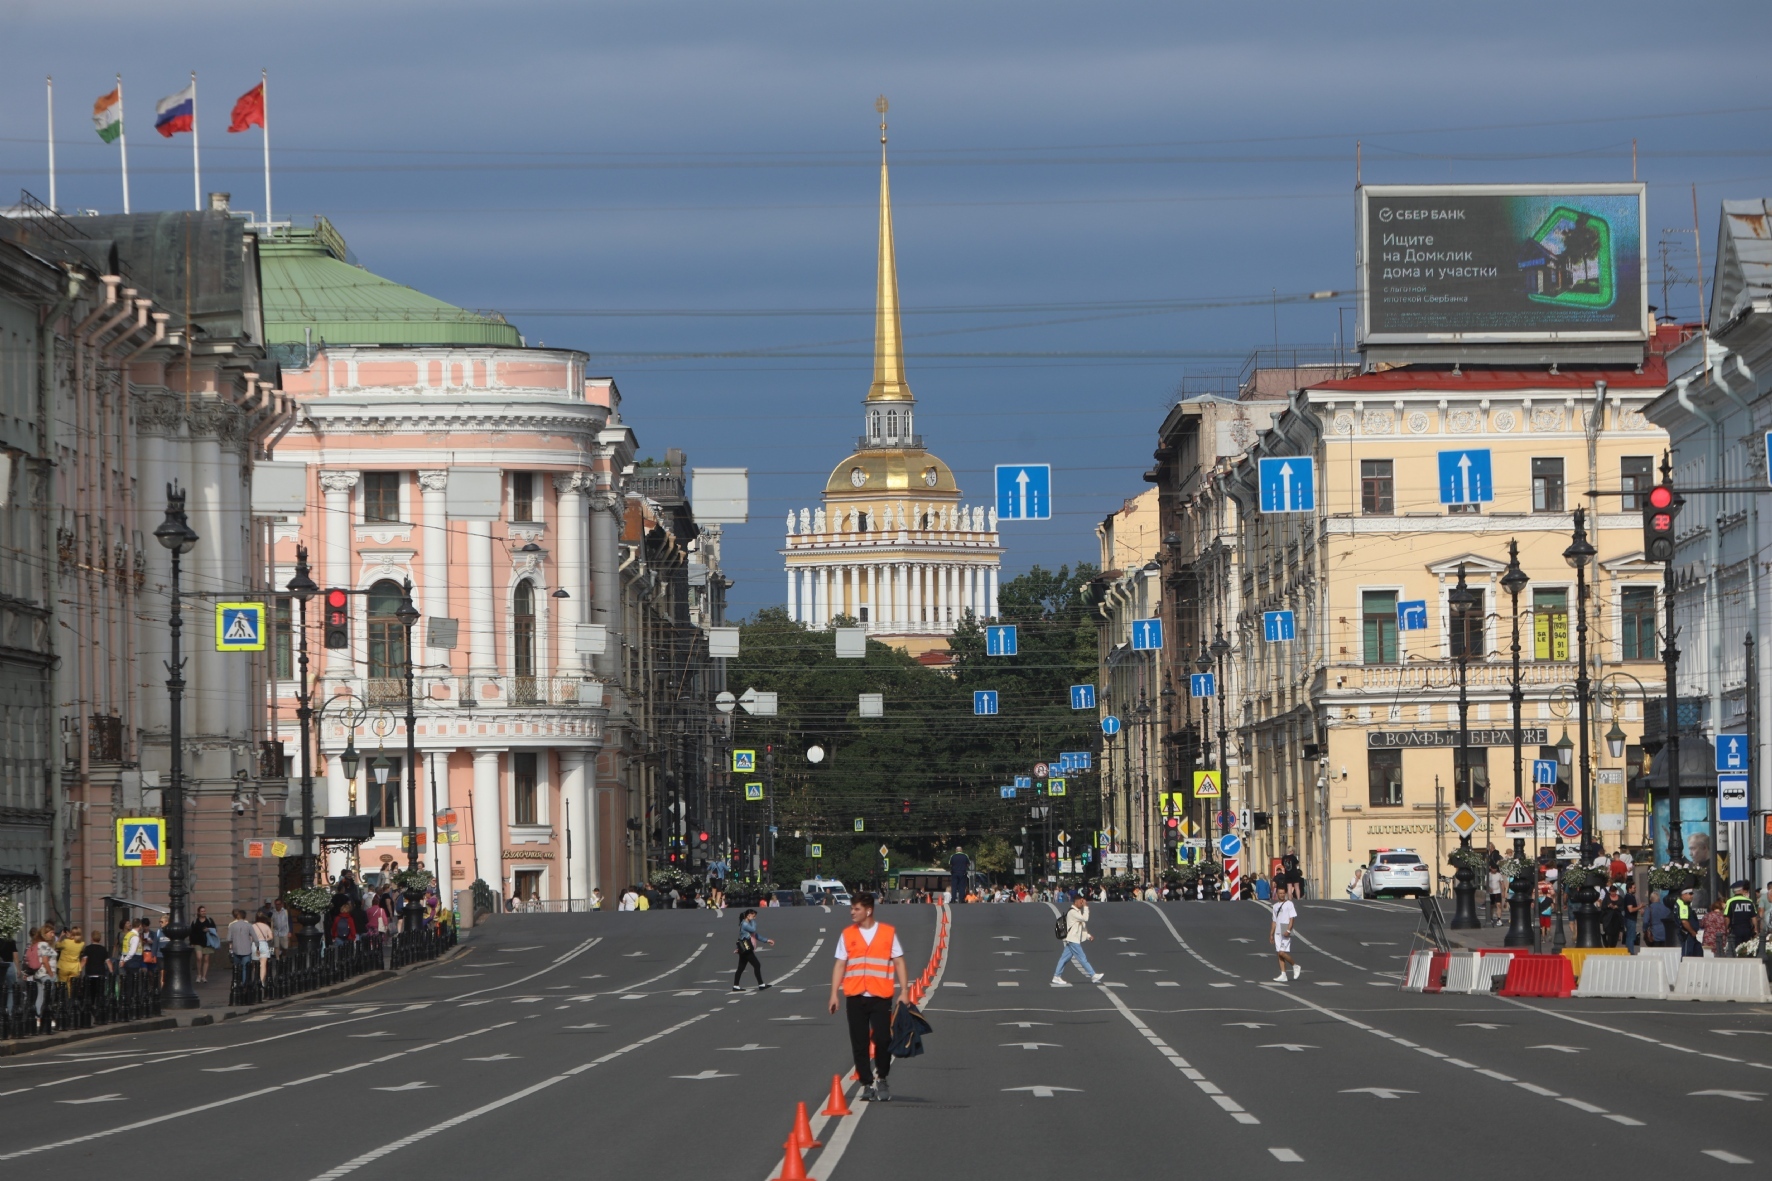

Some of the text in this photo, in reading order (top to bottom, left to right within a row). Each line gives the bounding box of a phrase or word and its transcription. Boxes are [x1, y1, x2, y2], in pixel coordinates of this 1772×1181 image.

[1396, 210, 1465, 220] СБЕР БАНК
[1383, 233, 1434, 247] Ищите
[1383, 249, 1472, 263] на Домклик
[1383, 267, 1497, 280] дома и участки
[1655, 514, 1670, 530] 32
[1369, 733, 1382, 746] С.
[1385, 732, 1444, 746] ВОЛФЪ
[1470, 730, 1546, 744] БЕРАЖЕ
[1734, 903, 1751, 912] ДПС
